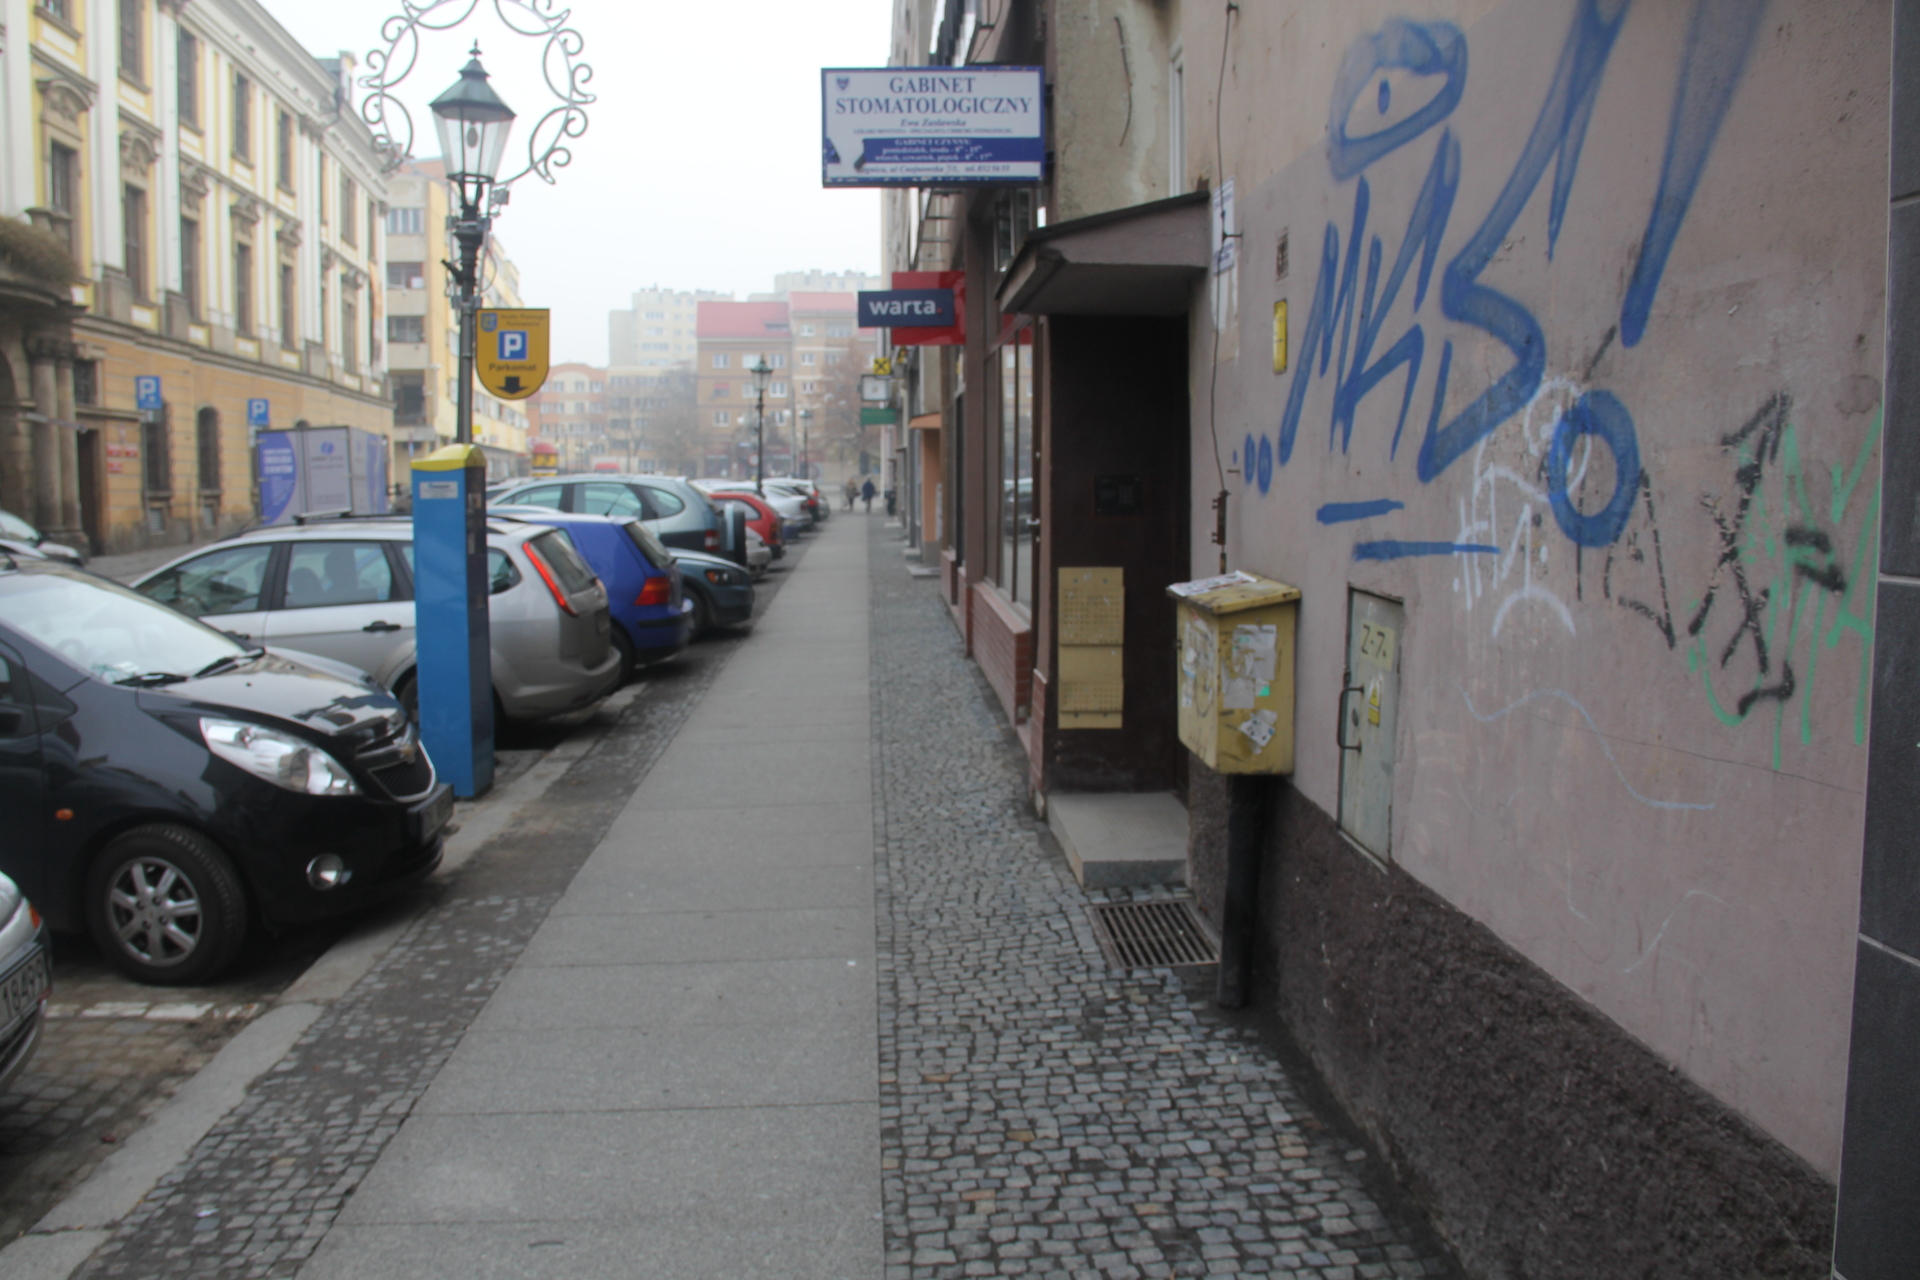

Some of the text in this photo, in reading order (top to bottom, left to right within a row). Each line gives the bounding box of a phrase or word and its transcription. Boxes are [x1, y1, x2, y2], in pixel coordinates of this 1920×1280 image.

[889, 76, 976, 93] GABINET
[835, 97, 1033, 115] STOMATOLOGICZNY
[488, 362, 537, 372] Parkomat
